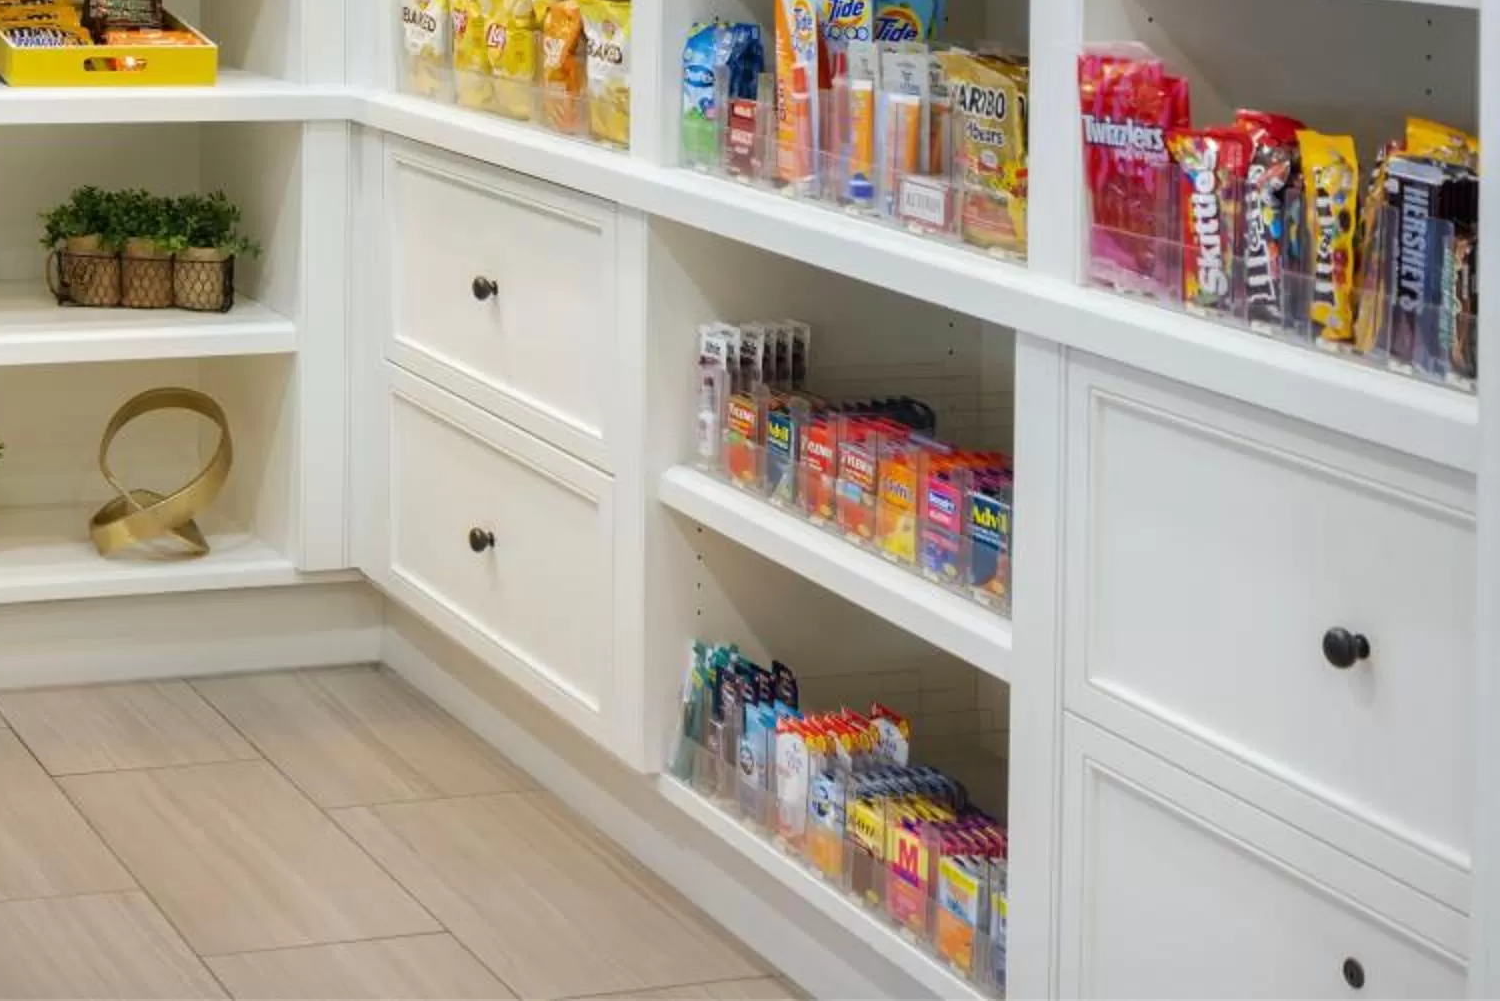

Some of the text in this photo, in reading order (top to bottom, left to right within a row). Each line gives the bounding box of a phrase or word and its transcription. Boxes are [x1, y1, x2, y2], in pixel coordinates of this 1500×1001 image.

[403, 6, 437, 33] BAKED
[875, 17, 919, 42] Tide
[586, 38, 624, 65] BAKED
[1080, 114, 1164, 150] Twizzlers
[1191, 137, 1228, 297] Skittles
[971, 504, 1008, 534] Advil
